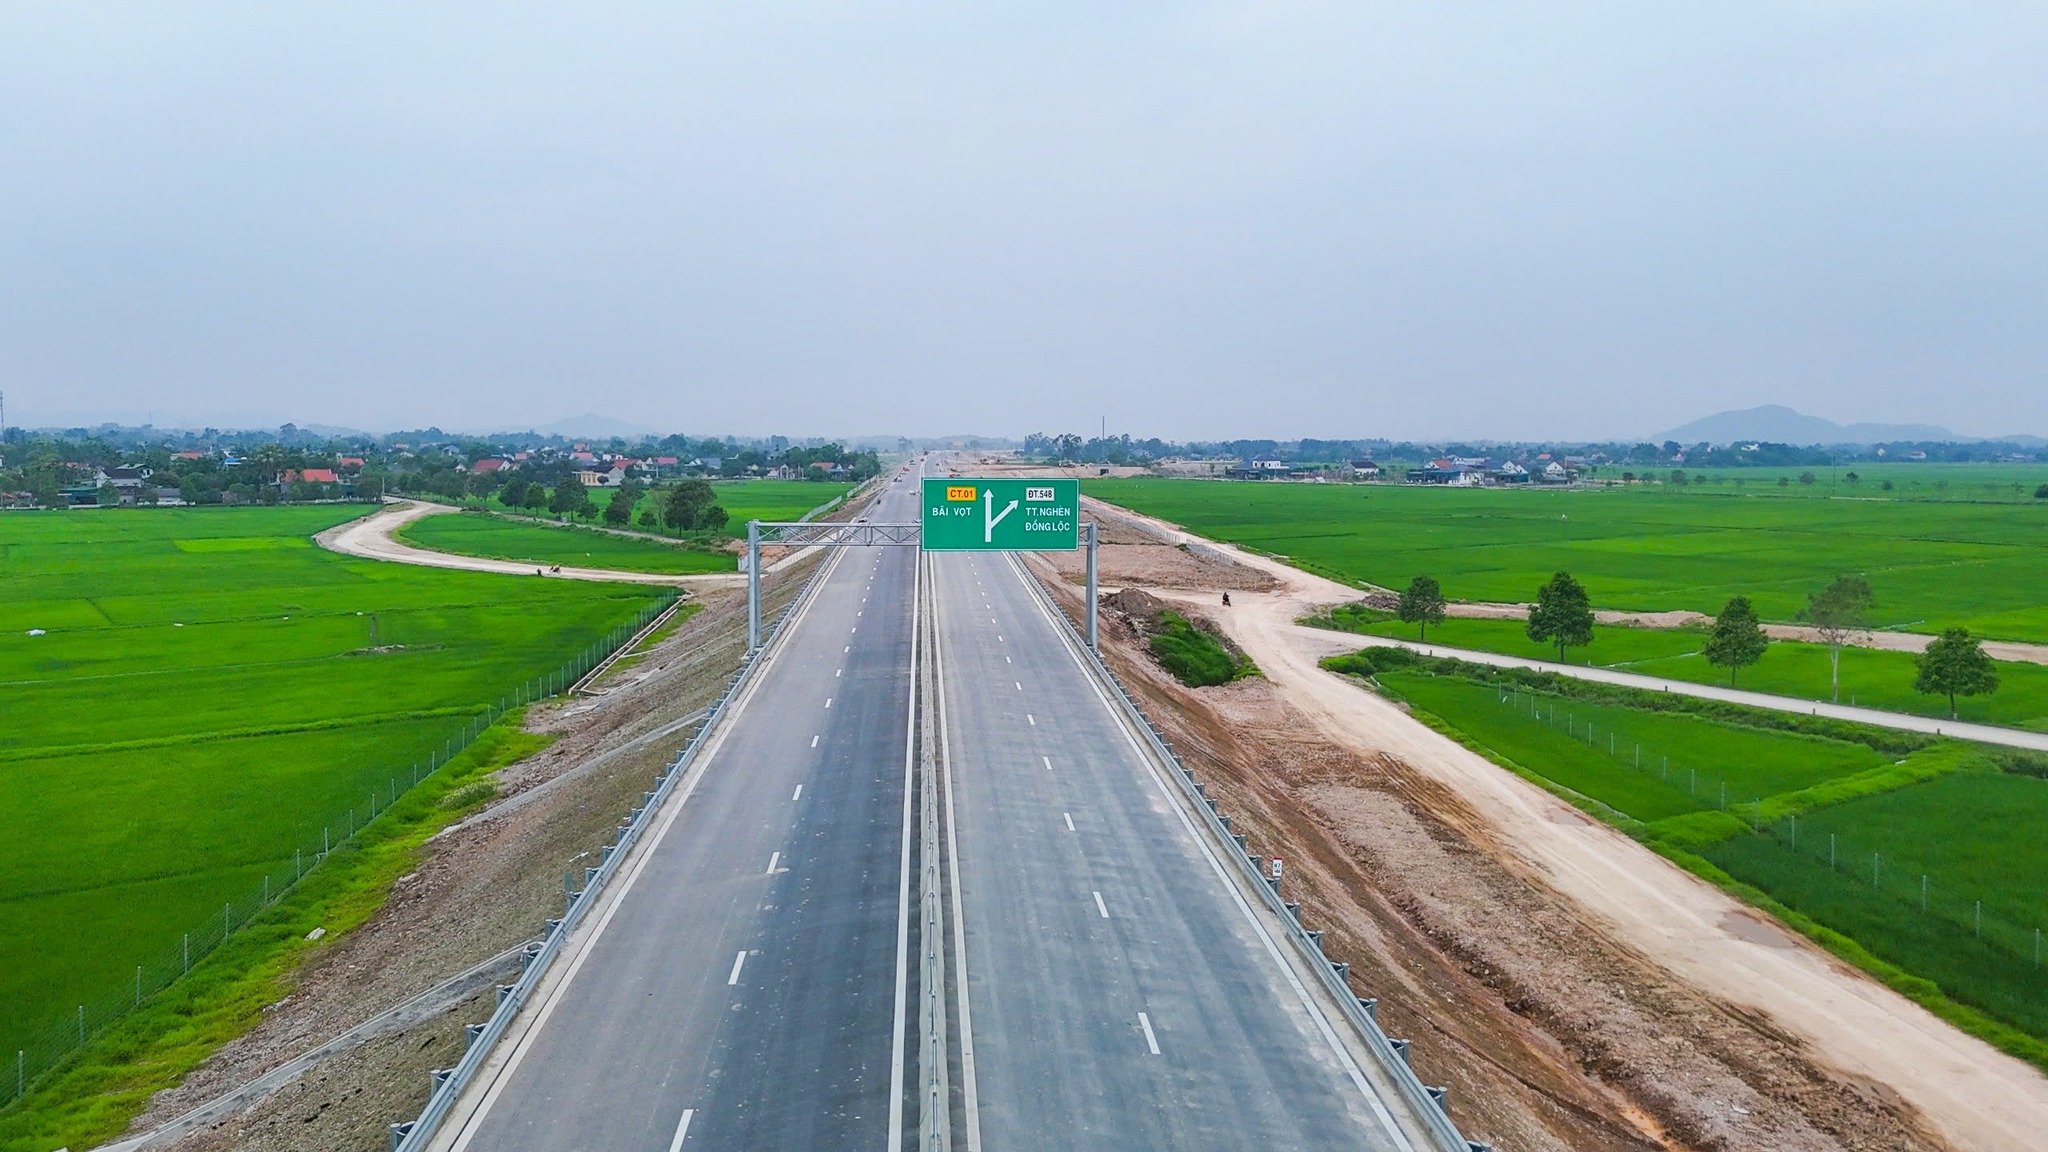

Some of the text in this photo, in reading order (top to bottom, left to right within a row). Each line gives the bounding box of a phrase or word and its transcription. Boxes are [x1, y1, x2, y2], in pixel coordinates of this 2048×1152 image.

[950, 490, 973, 498] CT.01
[1028, 490, 1053, 498] ĐT.548
[954, 507, 972, 517] VỌT
[1052, 521, 1070, 533] LỘC
